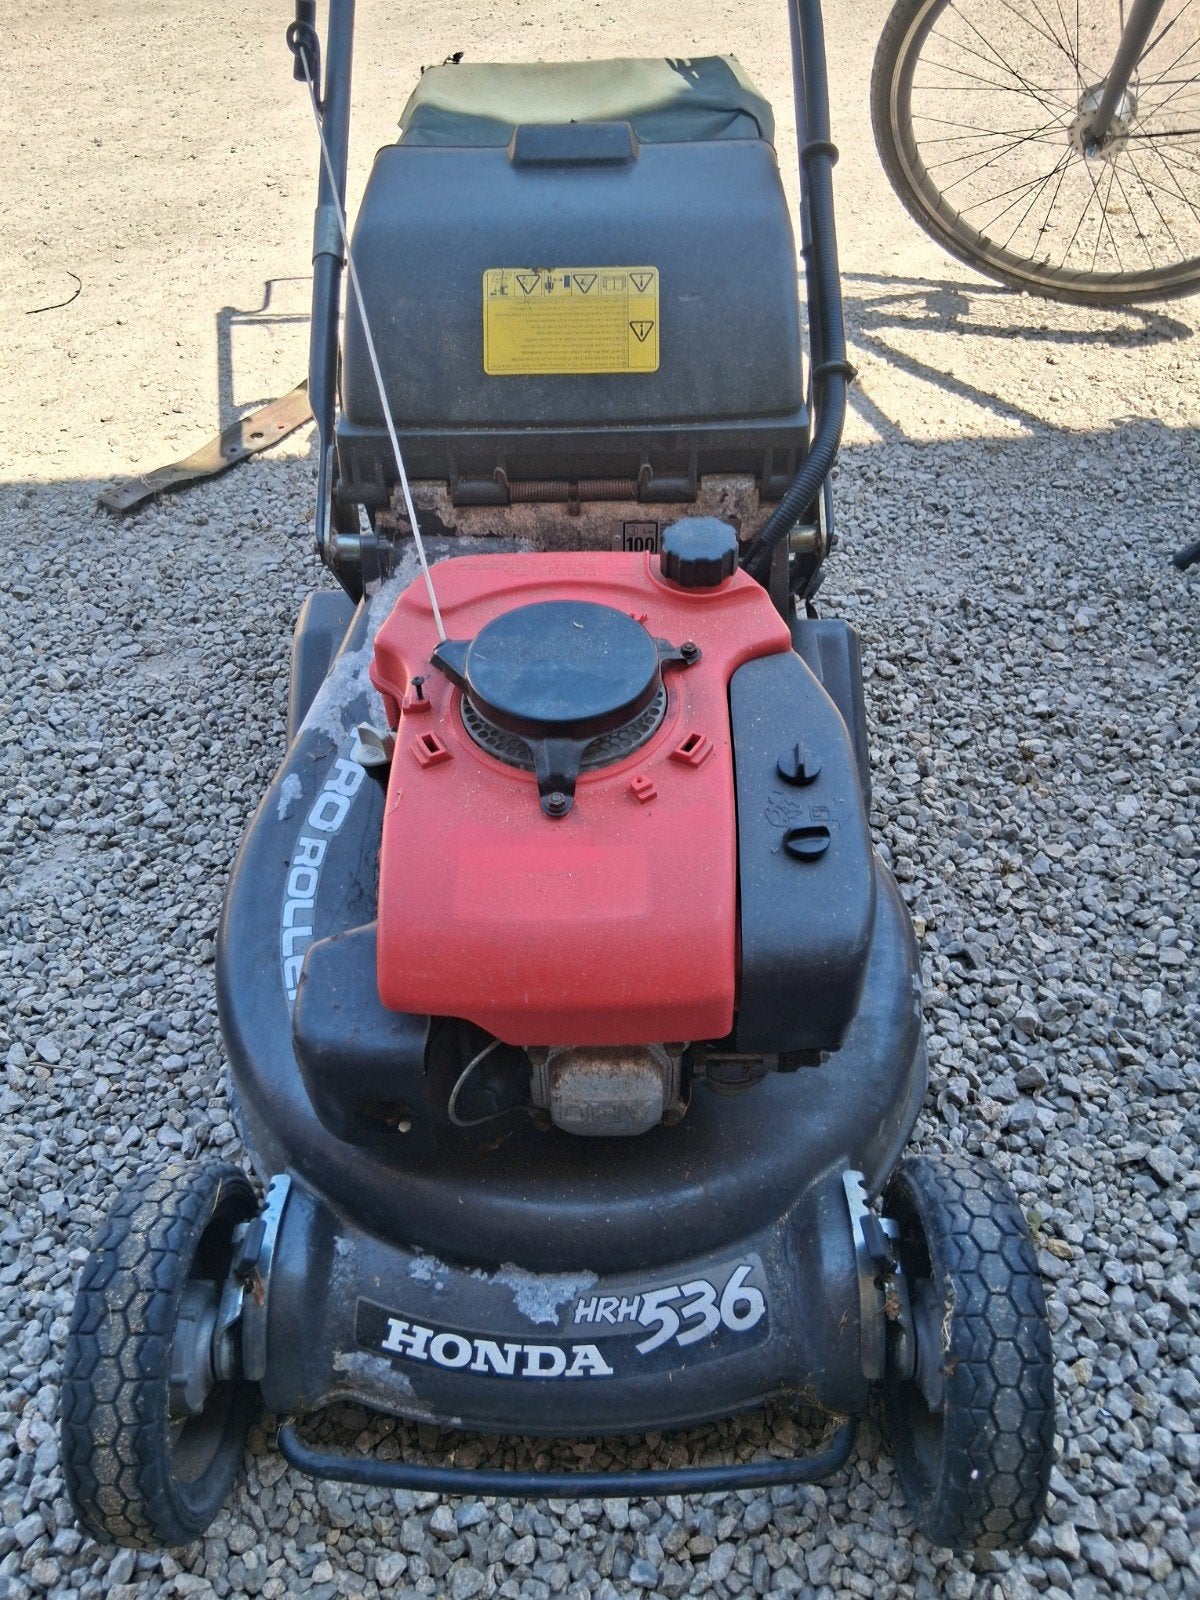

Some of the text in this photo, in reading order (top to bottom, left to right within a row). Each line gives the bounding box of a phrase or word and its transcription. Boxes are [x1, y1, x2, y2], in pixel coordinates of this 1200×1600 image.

[626, 536, 655, 553] 100
[574, 1265, 766, 1355] HRH 536
[381, 1317, 613, 1377] HONDA
